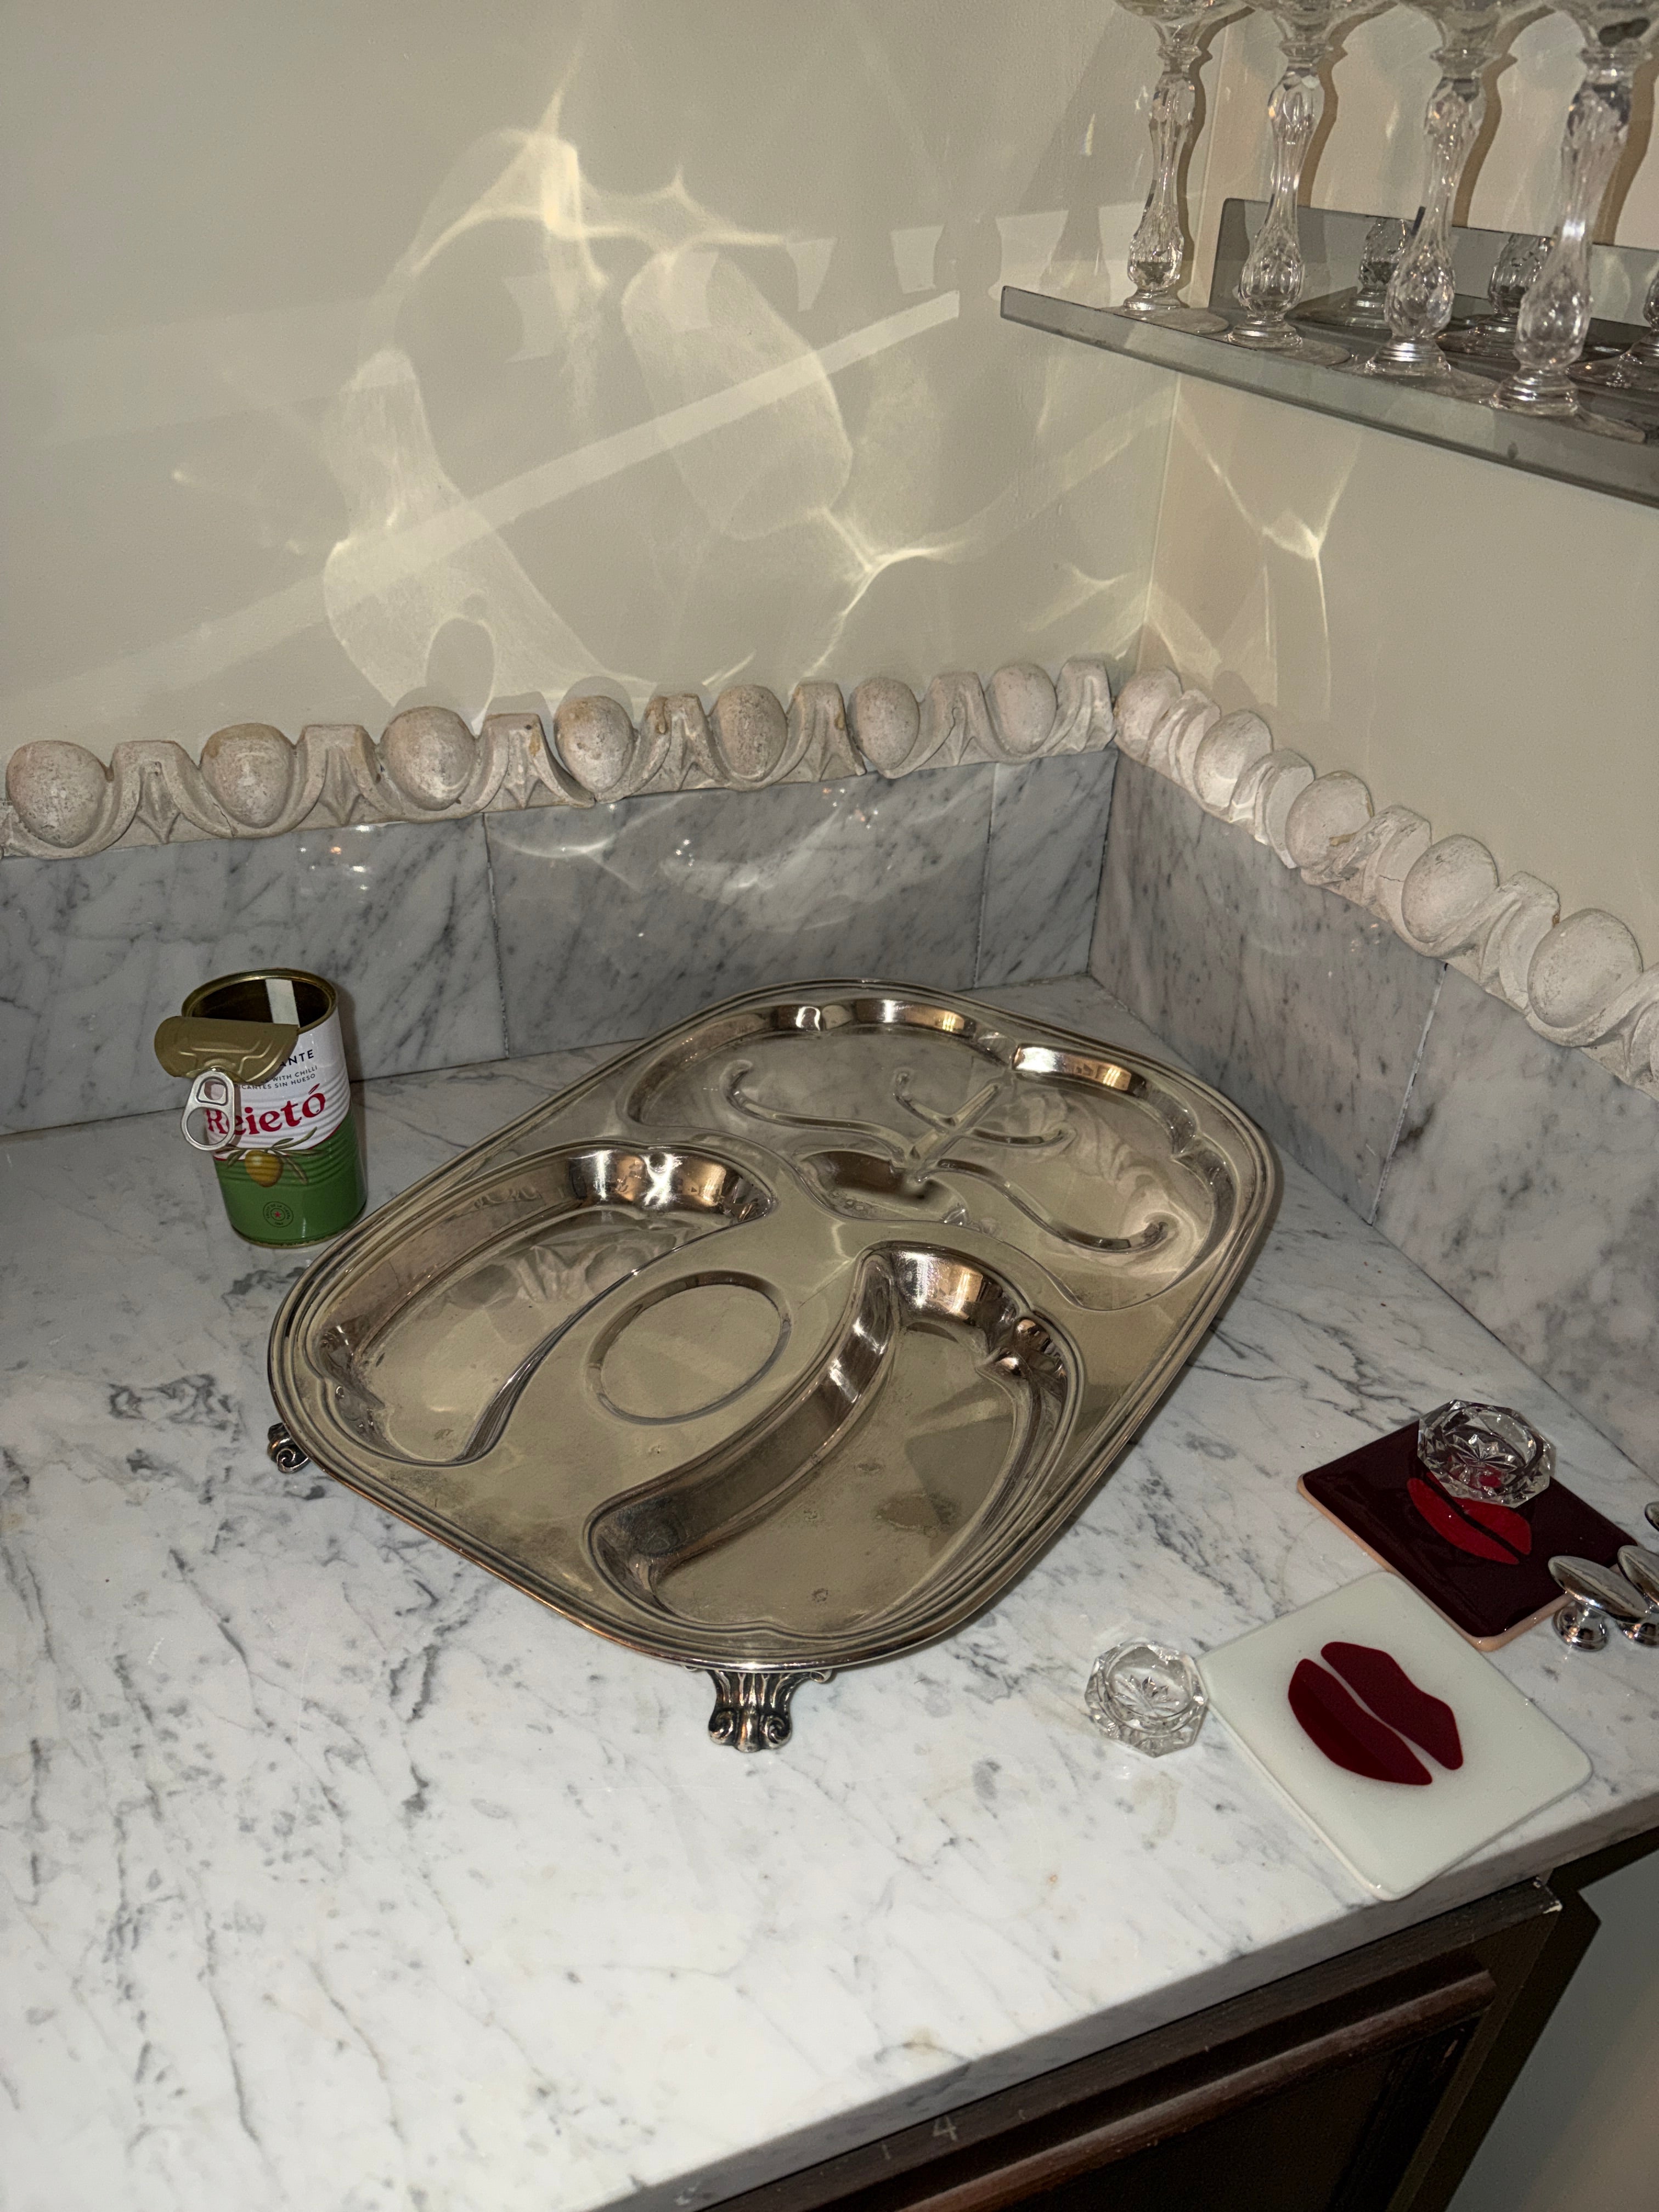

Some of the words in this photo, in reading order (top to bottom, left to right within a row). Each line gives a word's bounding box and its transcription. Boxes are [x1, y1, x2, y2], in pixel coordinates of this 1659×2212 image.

[295, 1065, 317, 1077] CHILLI
[291, 1074, 316, 1085] HUESO
[933, 2115, 957, 2141] 4
